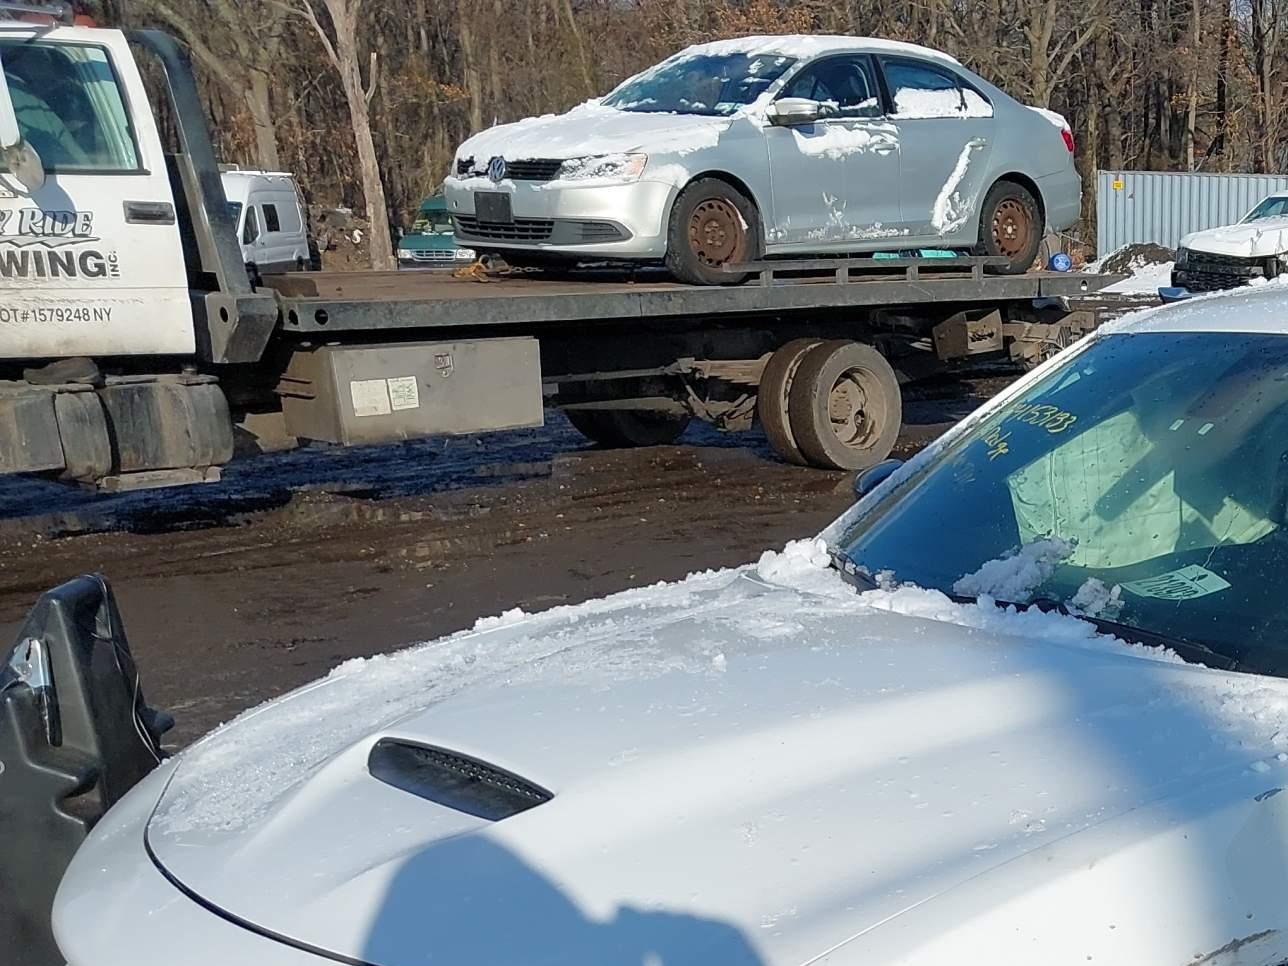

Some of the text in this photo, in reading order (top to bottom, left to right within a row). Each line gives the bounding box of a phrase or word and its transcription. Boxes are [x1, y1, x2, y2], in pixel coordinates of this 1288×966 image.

[19, 207, 93, 237] RIDE
[0, 250, 107, 277] WING
[93, 307, 112, 322] NY
